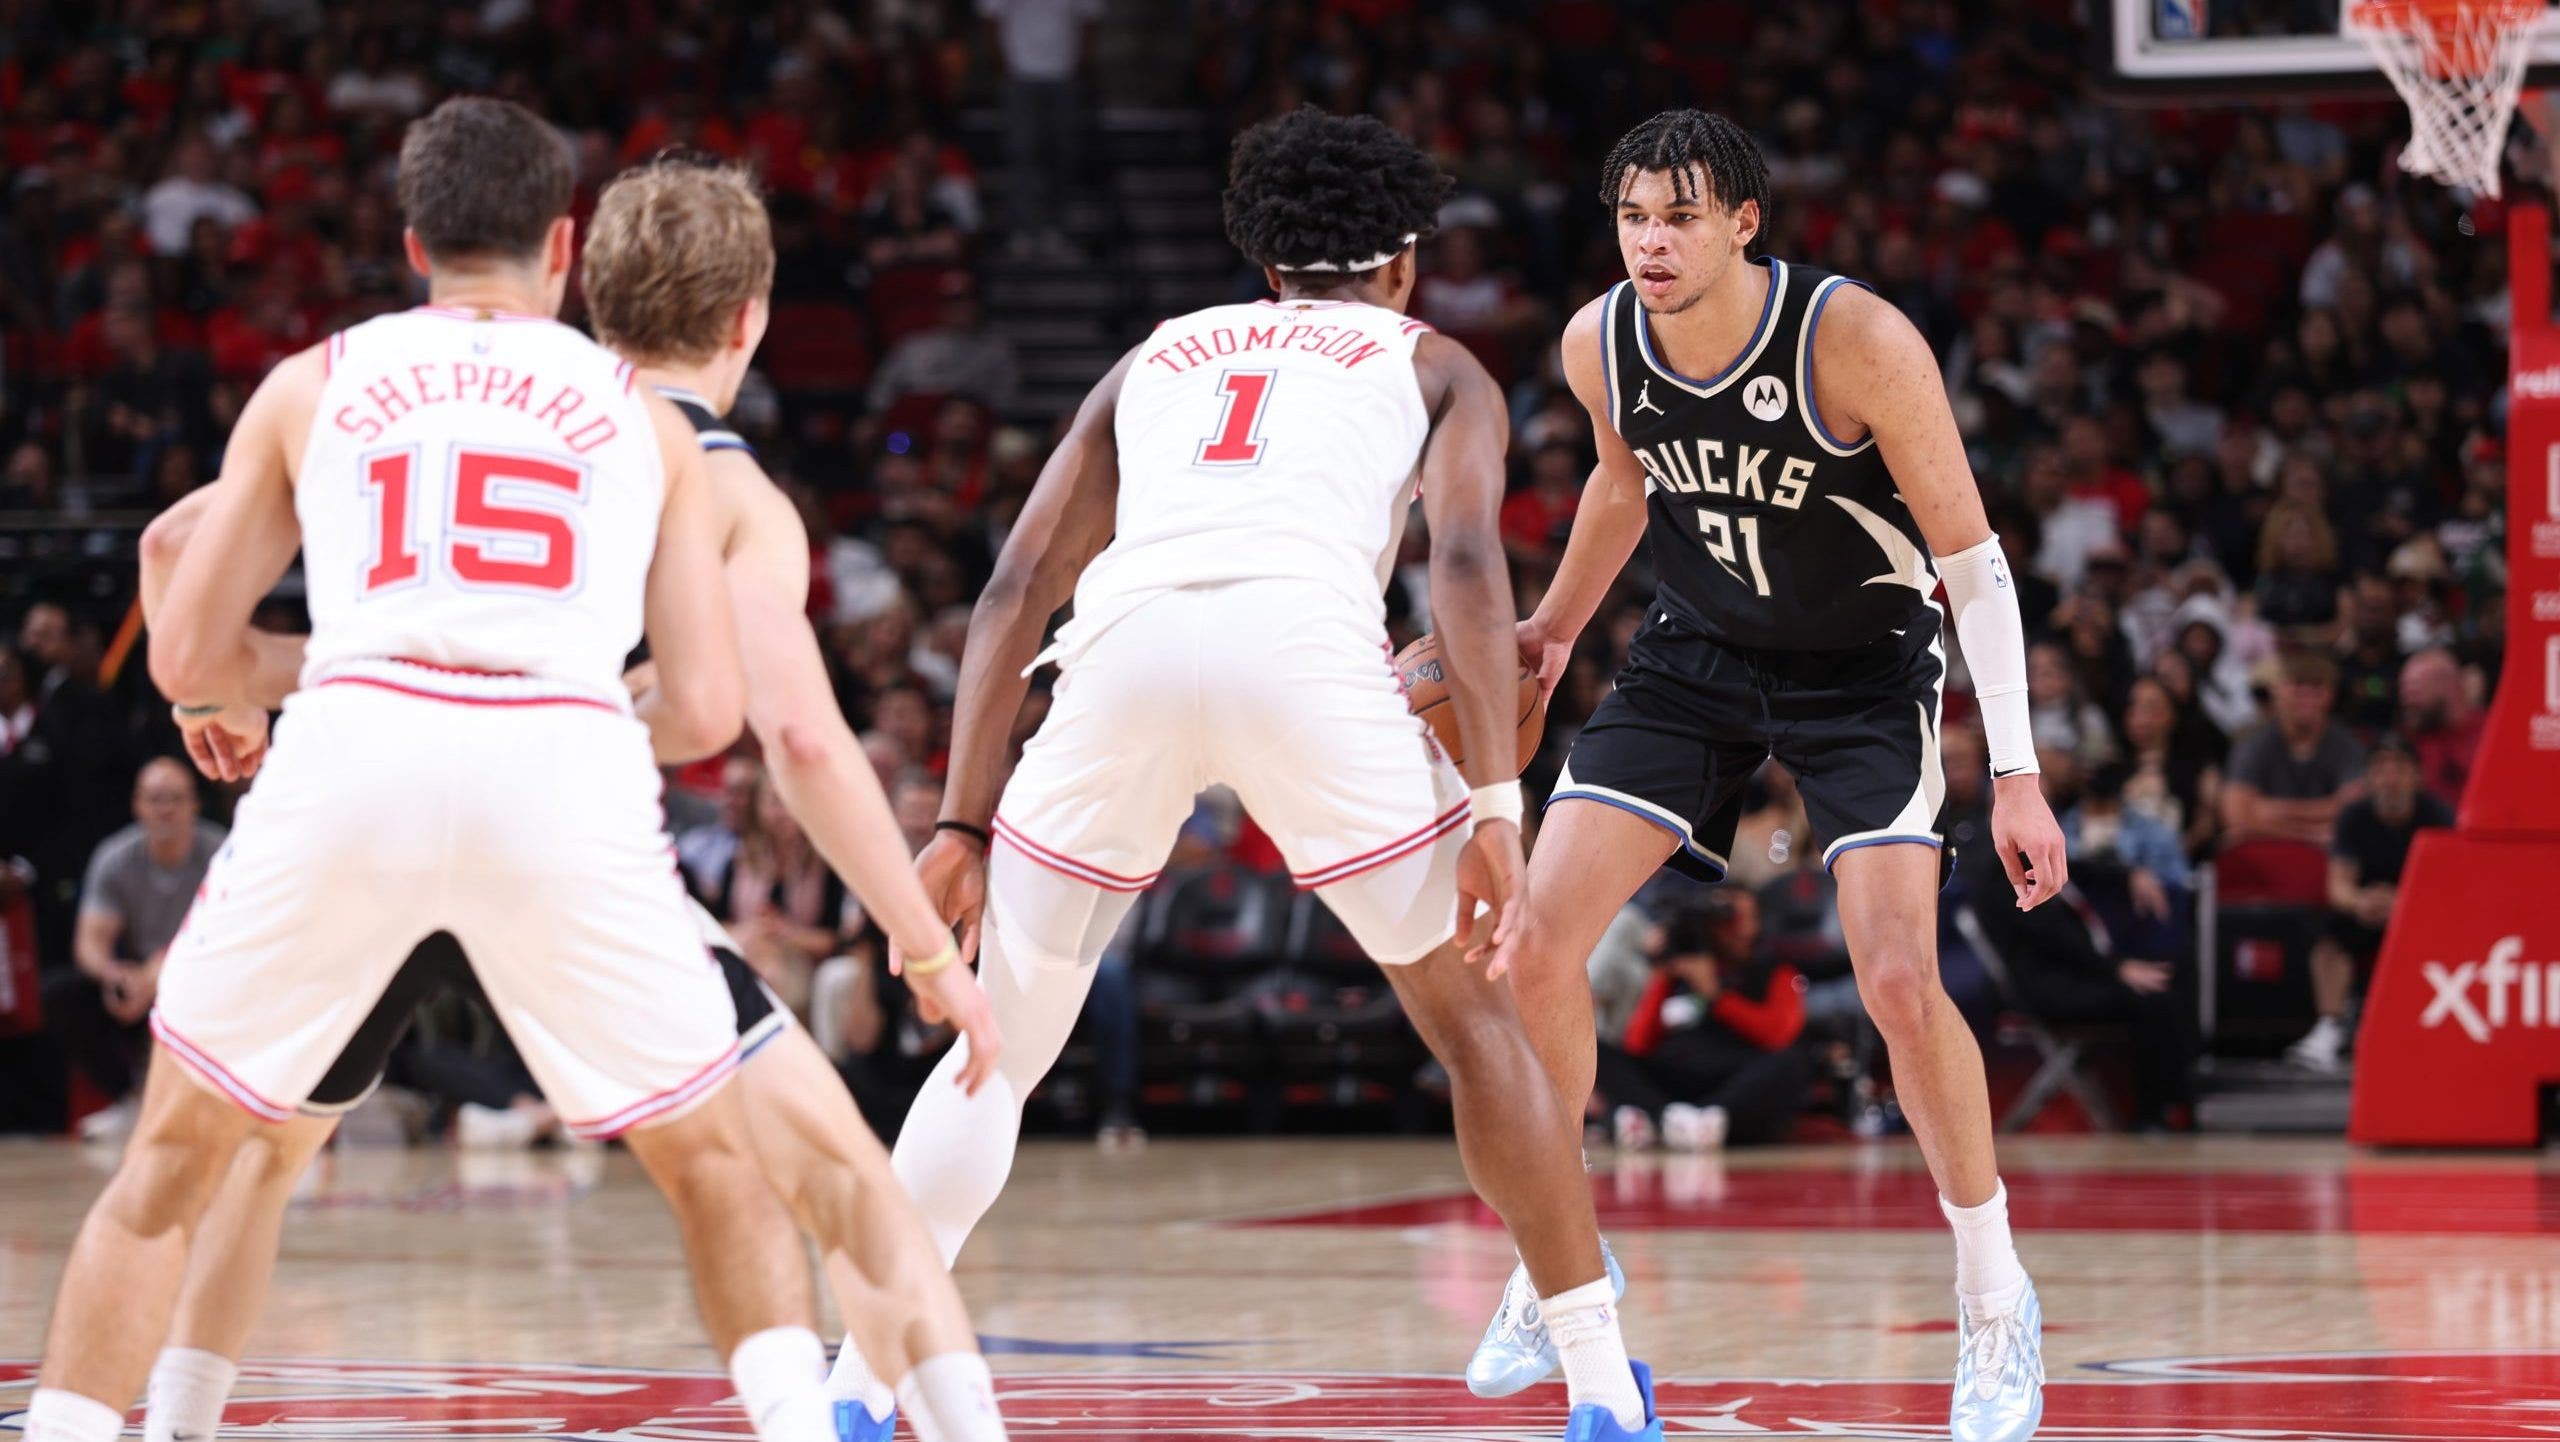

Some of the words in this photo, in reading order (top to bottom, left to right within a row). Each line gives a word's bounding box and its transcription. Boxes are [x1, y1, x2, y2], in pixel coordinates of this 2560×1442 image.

[1147, 324, 1388, 374] THOMPSON
[334, 361, 619, 455] SHEPPARD
[1191, 368, 1279, 467] 1
[1633, 438, 1816, 511] BUCKS
[357, 441, 593, 602] 15
[1697, 508, 1771, 597] 21
